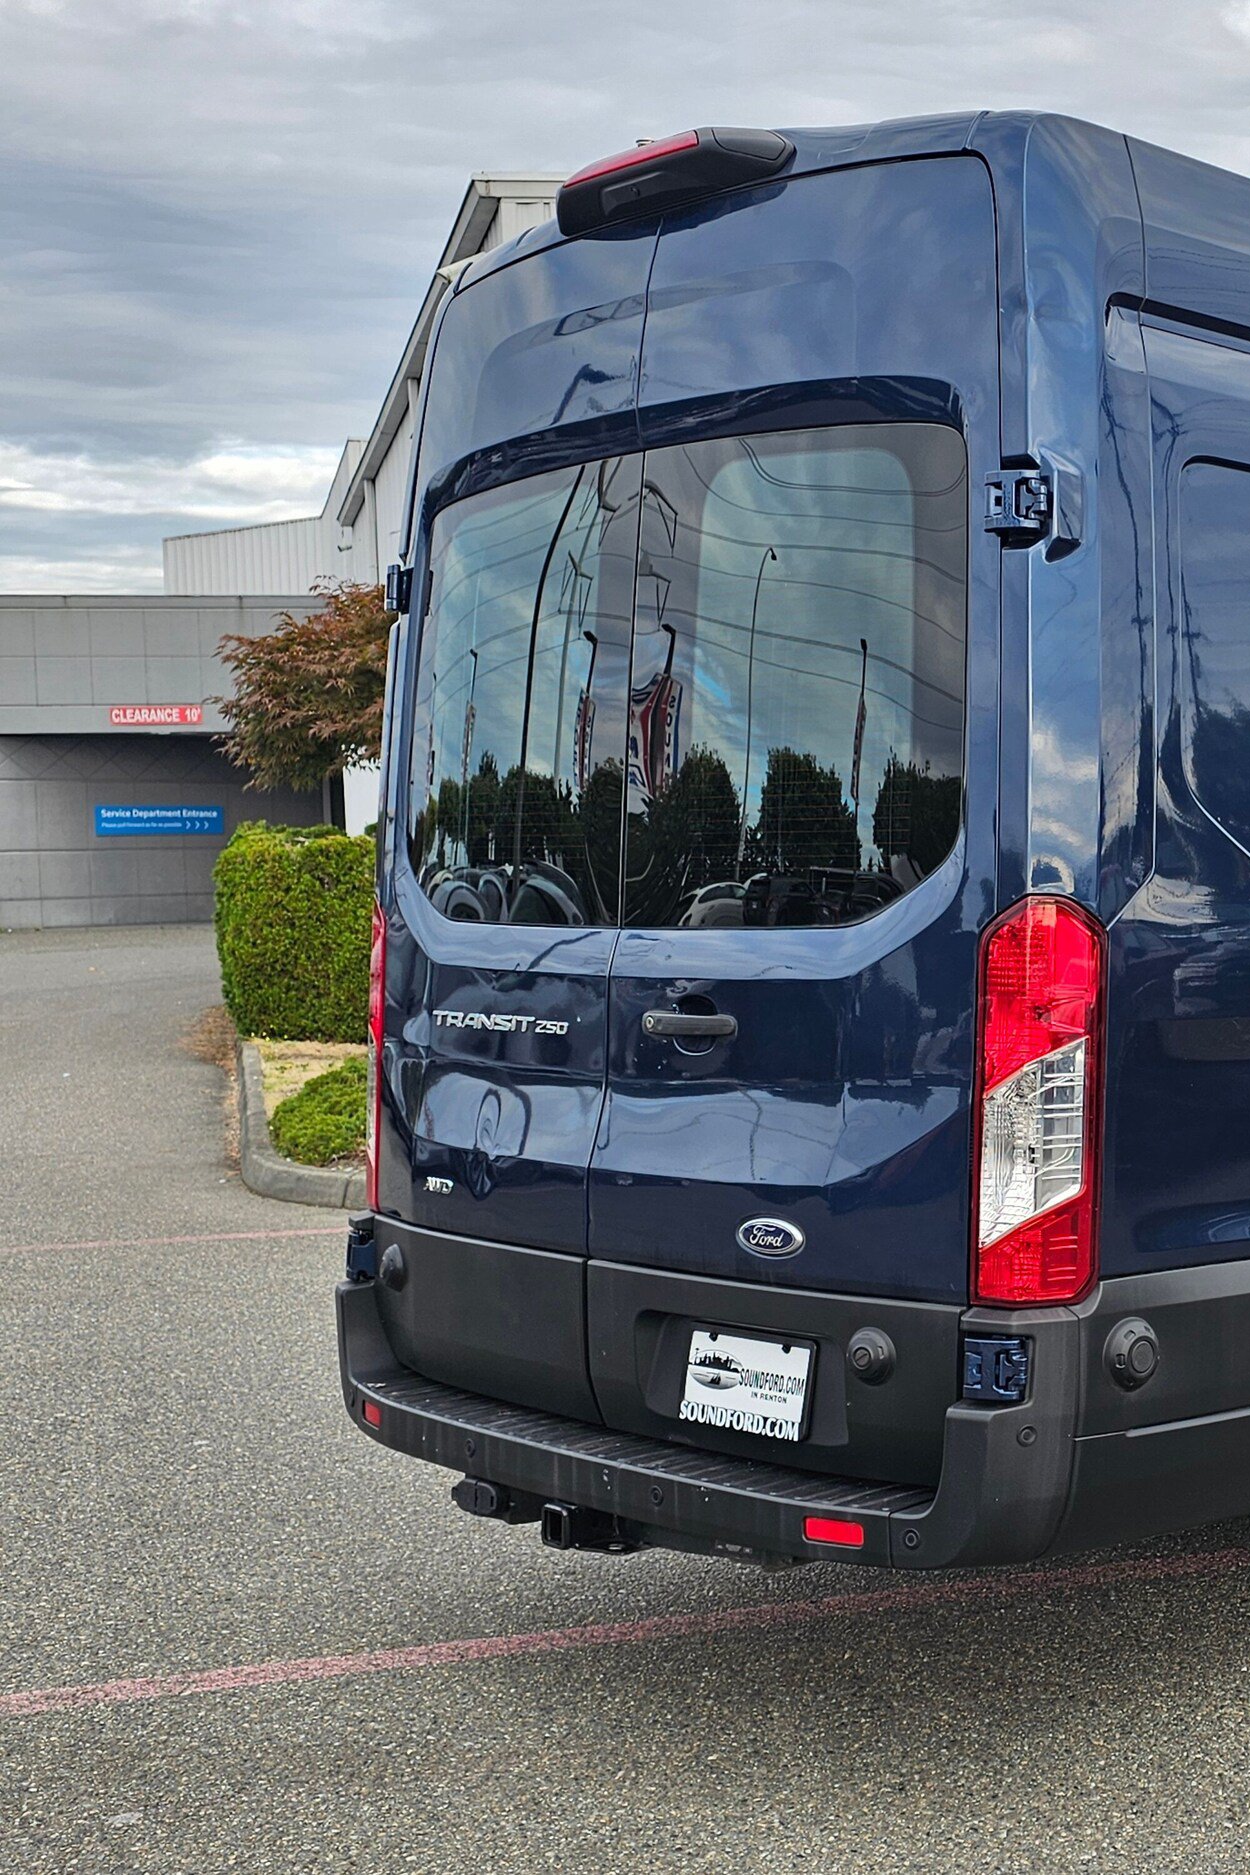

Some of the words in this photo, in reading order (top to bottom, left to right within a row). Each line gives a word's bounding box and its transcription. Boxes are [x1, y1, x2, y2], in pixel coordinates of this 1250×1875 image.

[111, 708, 180, 723] CLEARANCE
[100, 808, 131, 818] Service
[132, 808, 181, 820] Department
[182, 808, 218, 818] Entrance
[432, 1009, 535, 1033] TRANSIT
[534, 1019, 569, 1035] 250
[423, 1176, 454, 1195] AWD
[749, 1225, 785, 1247] Ford
[738, 1368, 805, 1397] SOUNDFORD.COM
[751, 1391, 758, 1399] IN
[759, 1392, 788, 1404] RENTON
[678, 1399, 800, 1442] SOUNDFORD.COM
